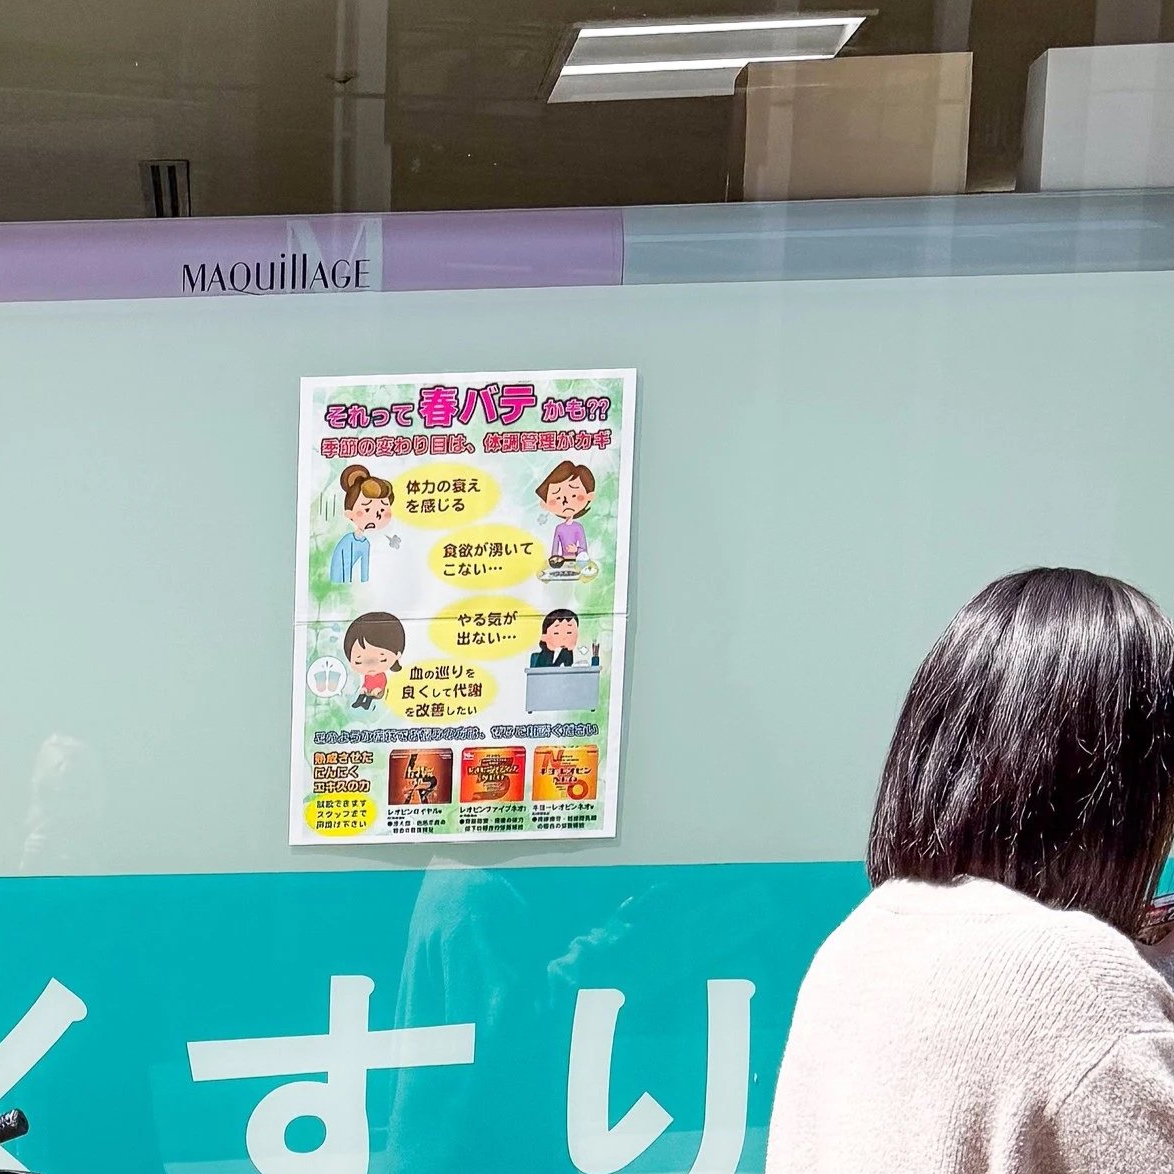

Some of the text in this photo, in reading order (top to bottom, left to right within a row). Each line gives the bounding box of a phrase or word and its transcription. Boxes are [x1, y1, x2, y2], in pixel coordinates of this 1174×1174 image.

[325, 403, 413, 428] それって
[418, 383, 536, 427] 春バテ
[406, 479, 481, 495] 体力の衰え
[406, 498, 466, 514] を感じる
[443, 541, 534, 558] 食欲が湧いて
[457, 611, 518, 627] やる気が
[409, 665, 475, 681] 血の巡りを
[401, 683, 482, 700] 良くして代謝
[405, 702, 477, 718] を改善したい
[313, 751, 373, 765] 熟成させた
[313, 766, 359, 779] にんにく
[313, 780, 371, 793] エキスの力
